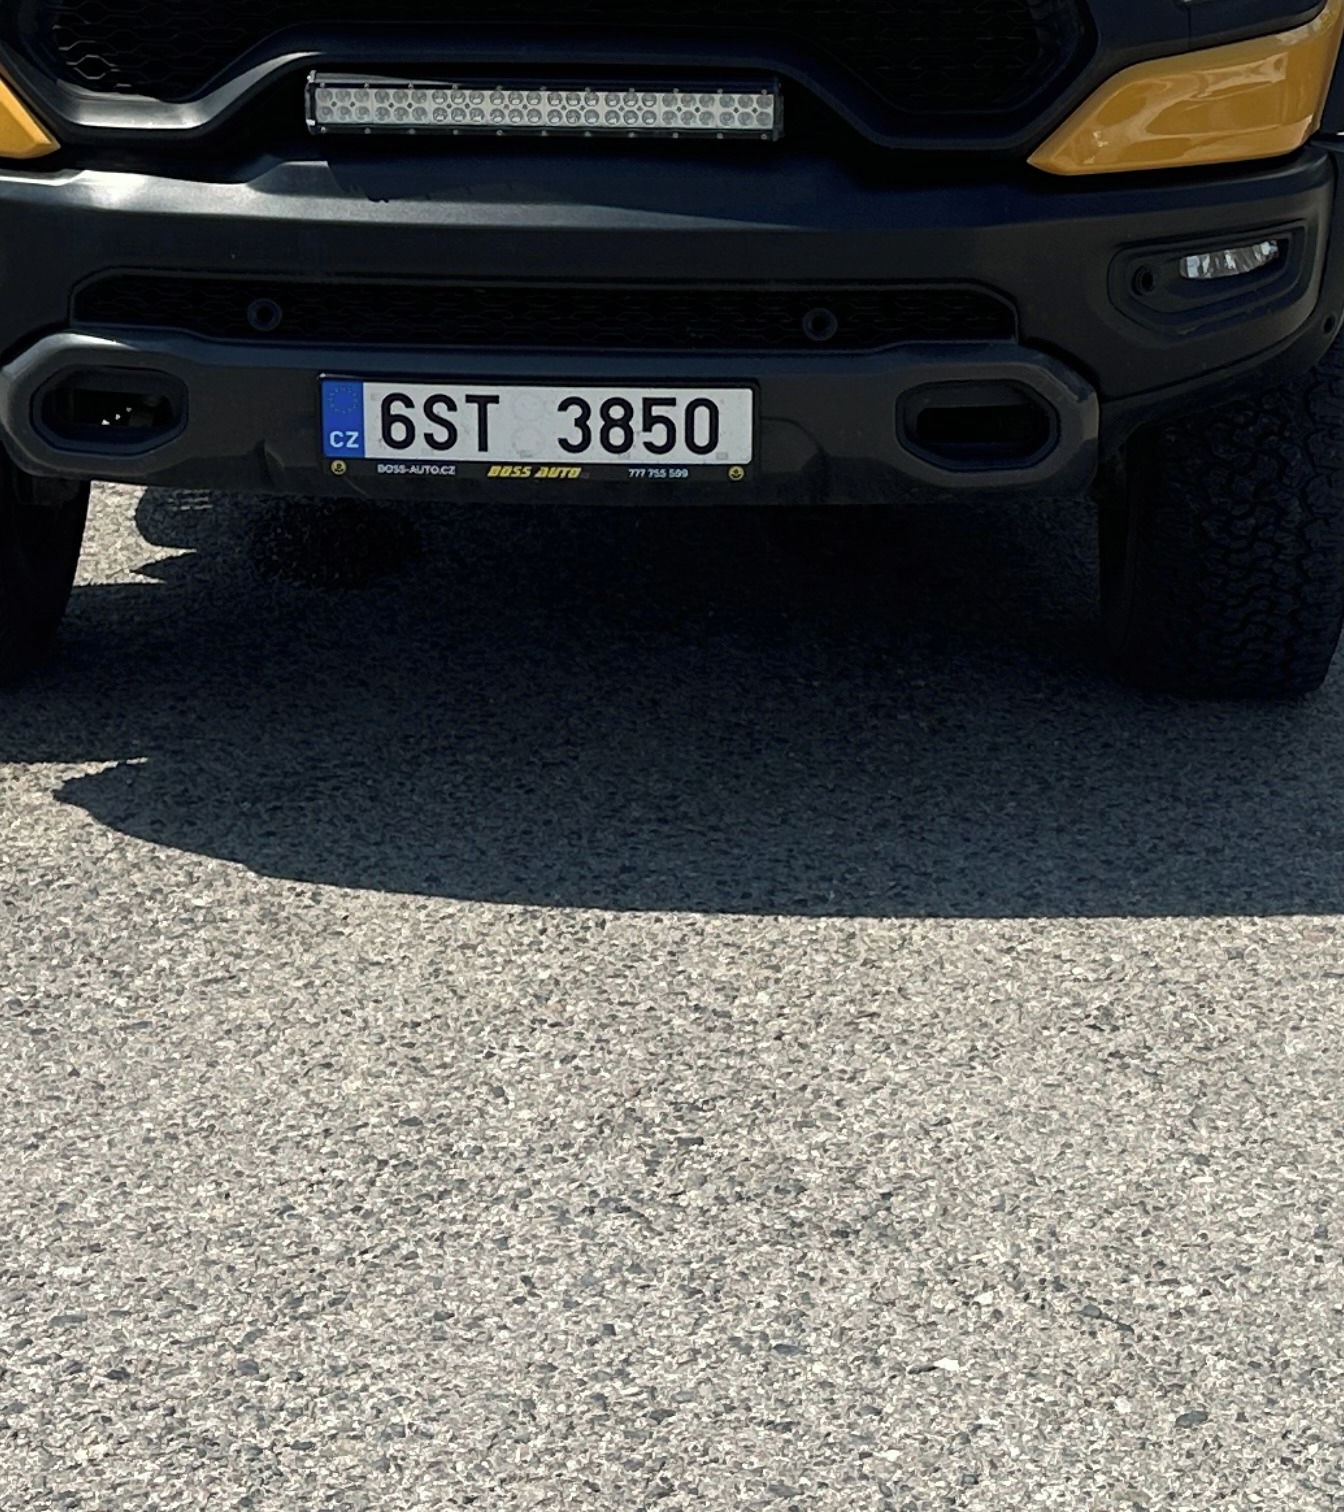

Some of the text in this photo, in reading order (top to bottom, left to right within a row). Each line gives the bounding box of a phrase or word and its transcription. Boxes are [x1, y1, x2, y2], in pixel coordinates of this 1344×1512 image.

[380, 392, 720, 456] 6ST 3850
[329, 430, 360, 449] CZ
[377, 464, 456, 475] BOSS-AUTO.CZ
[487, 465, 582, 479] BOSS AUTO
